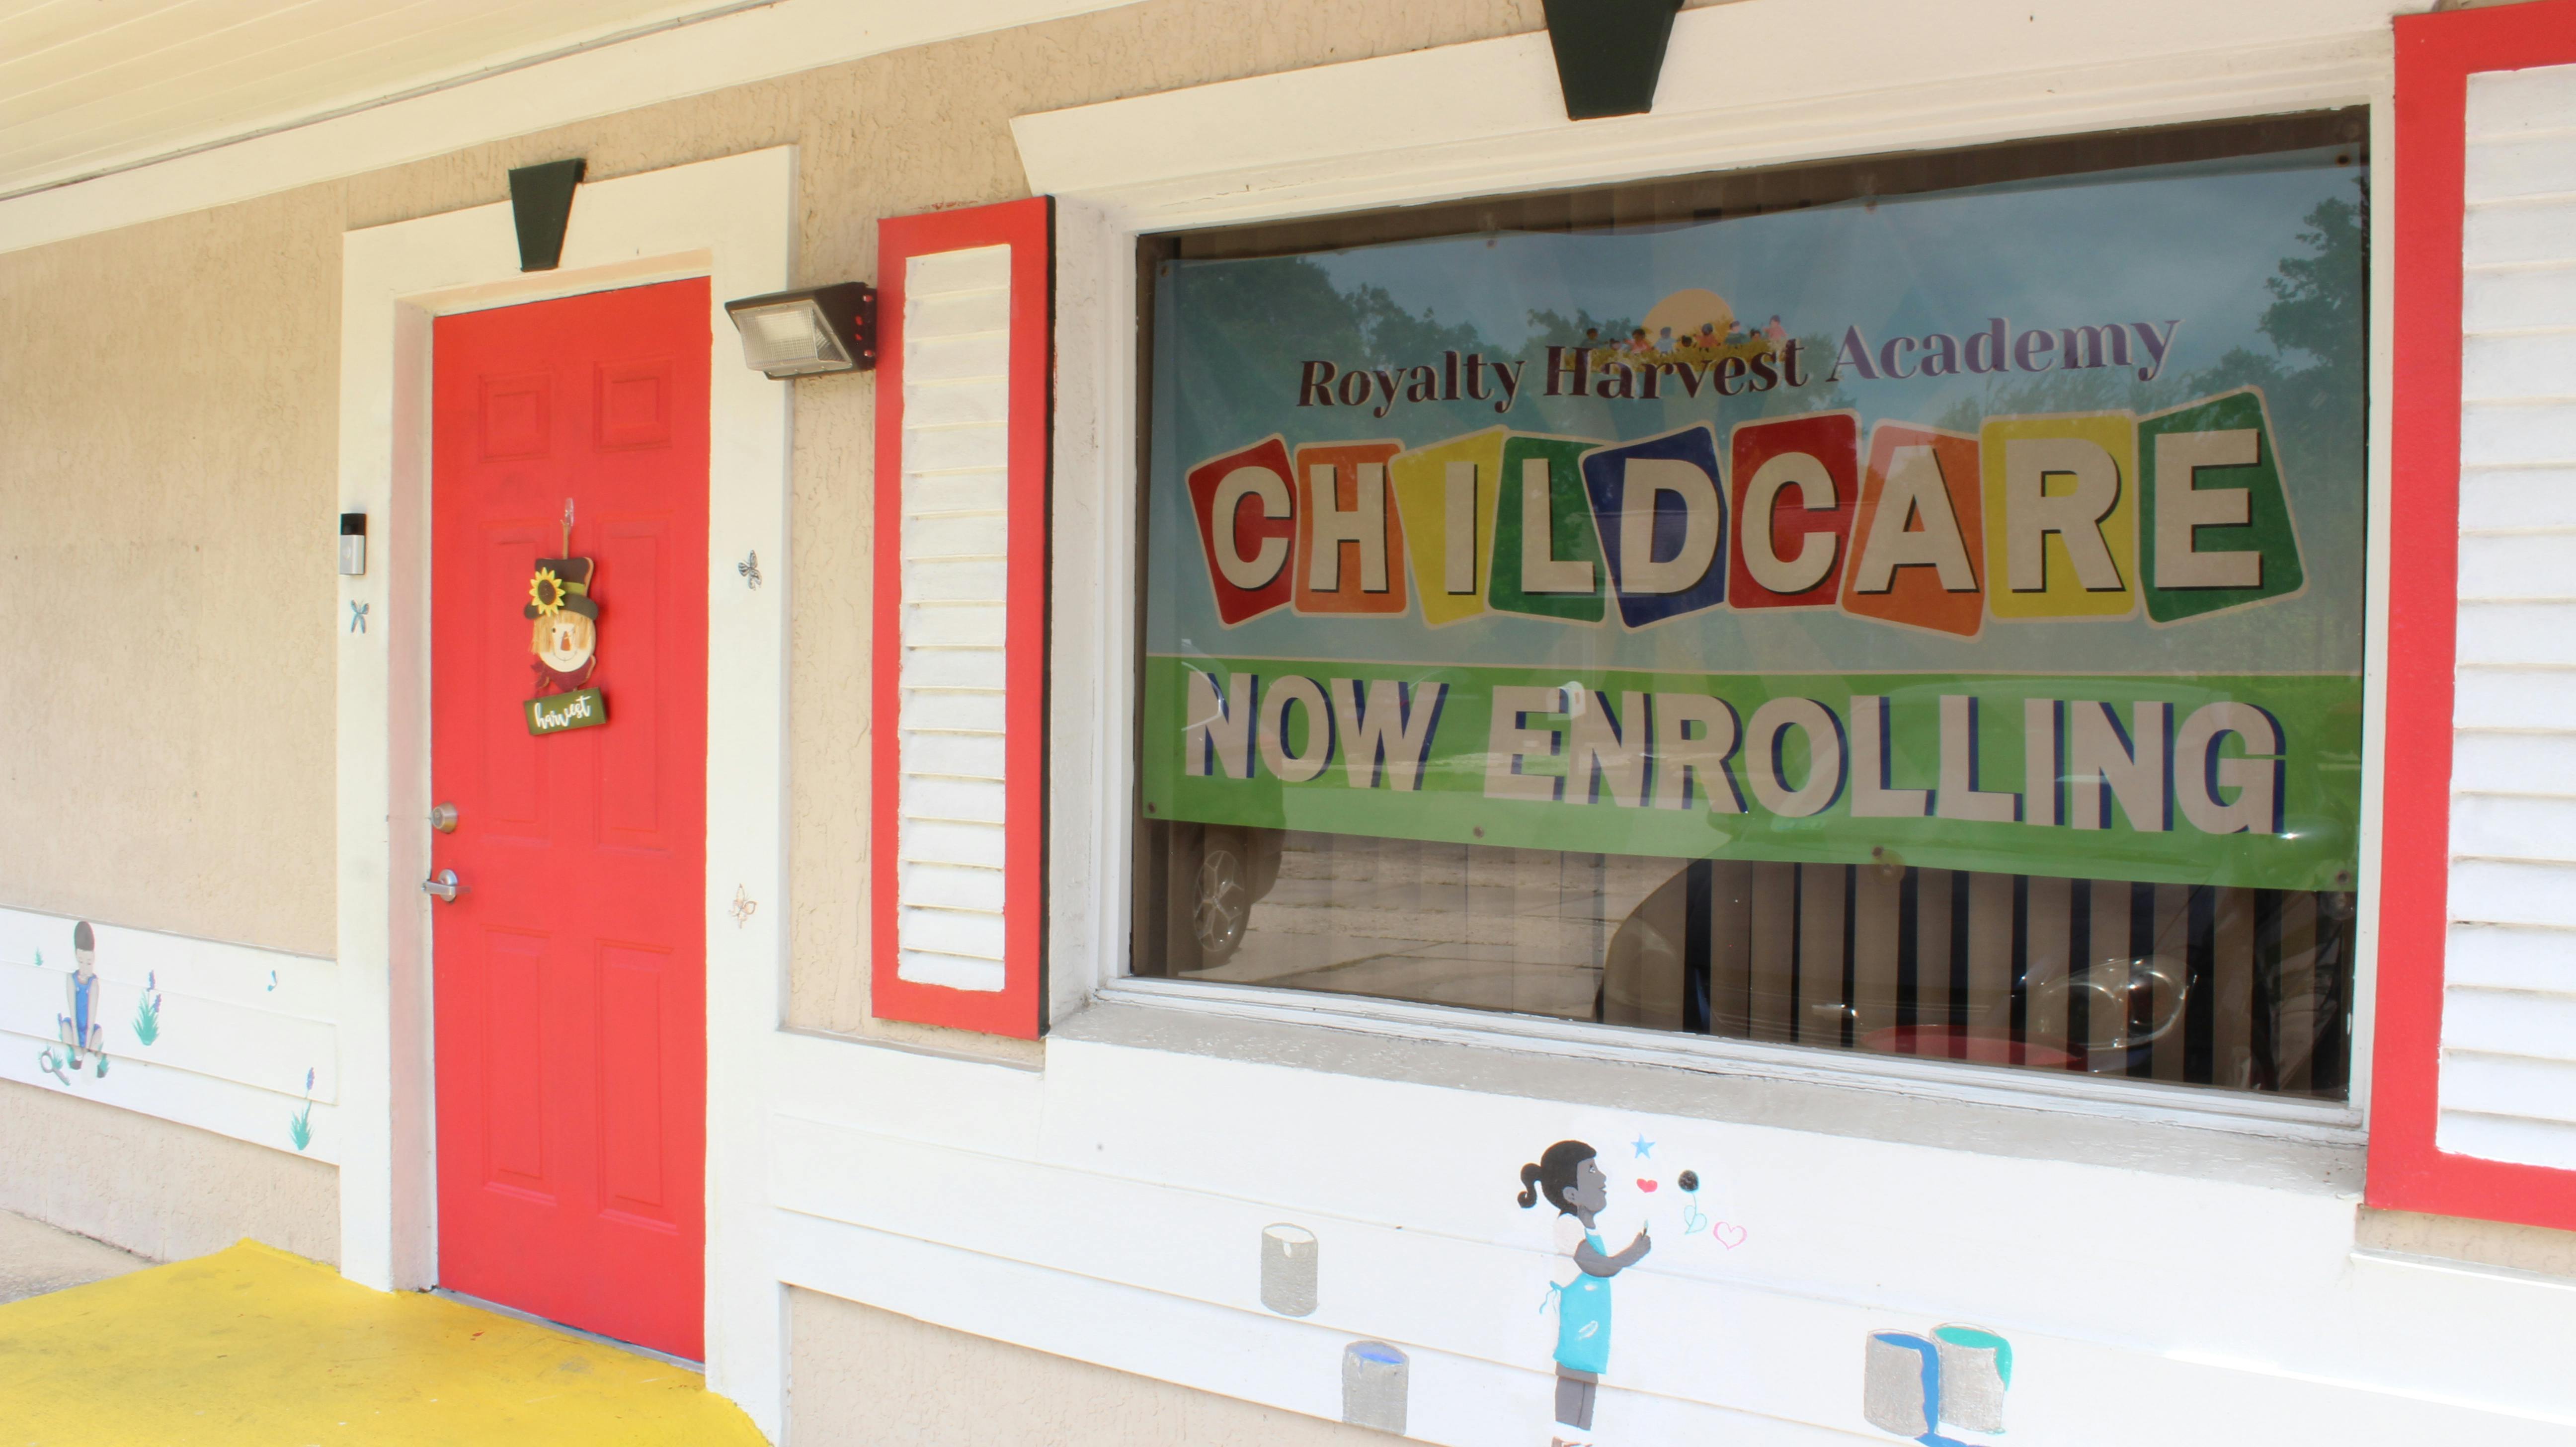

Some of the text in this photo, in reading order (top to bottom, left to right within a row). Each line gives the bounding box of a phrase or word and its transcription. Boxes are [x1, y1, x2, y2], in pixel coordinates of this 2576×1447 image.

[1296, 317, 2182, 418] Royalty Harvest Academy
[1211, 428, 2264, 595] CHILDCARE
[534, 695, 592, 730] harvest
[1185, 670, 2287, 835] NOW ENROLLING
